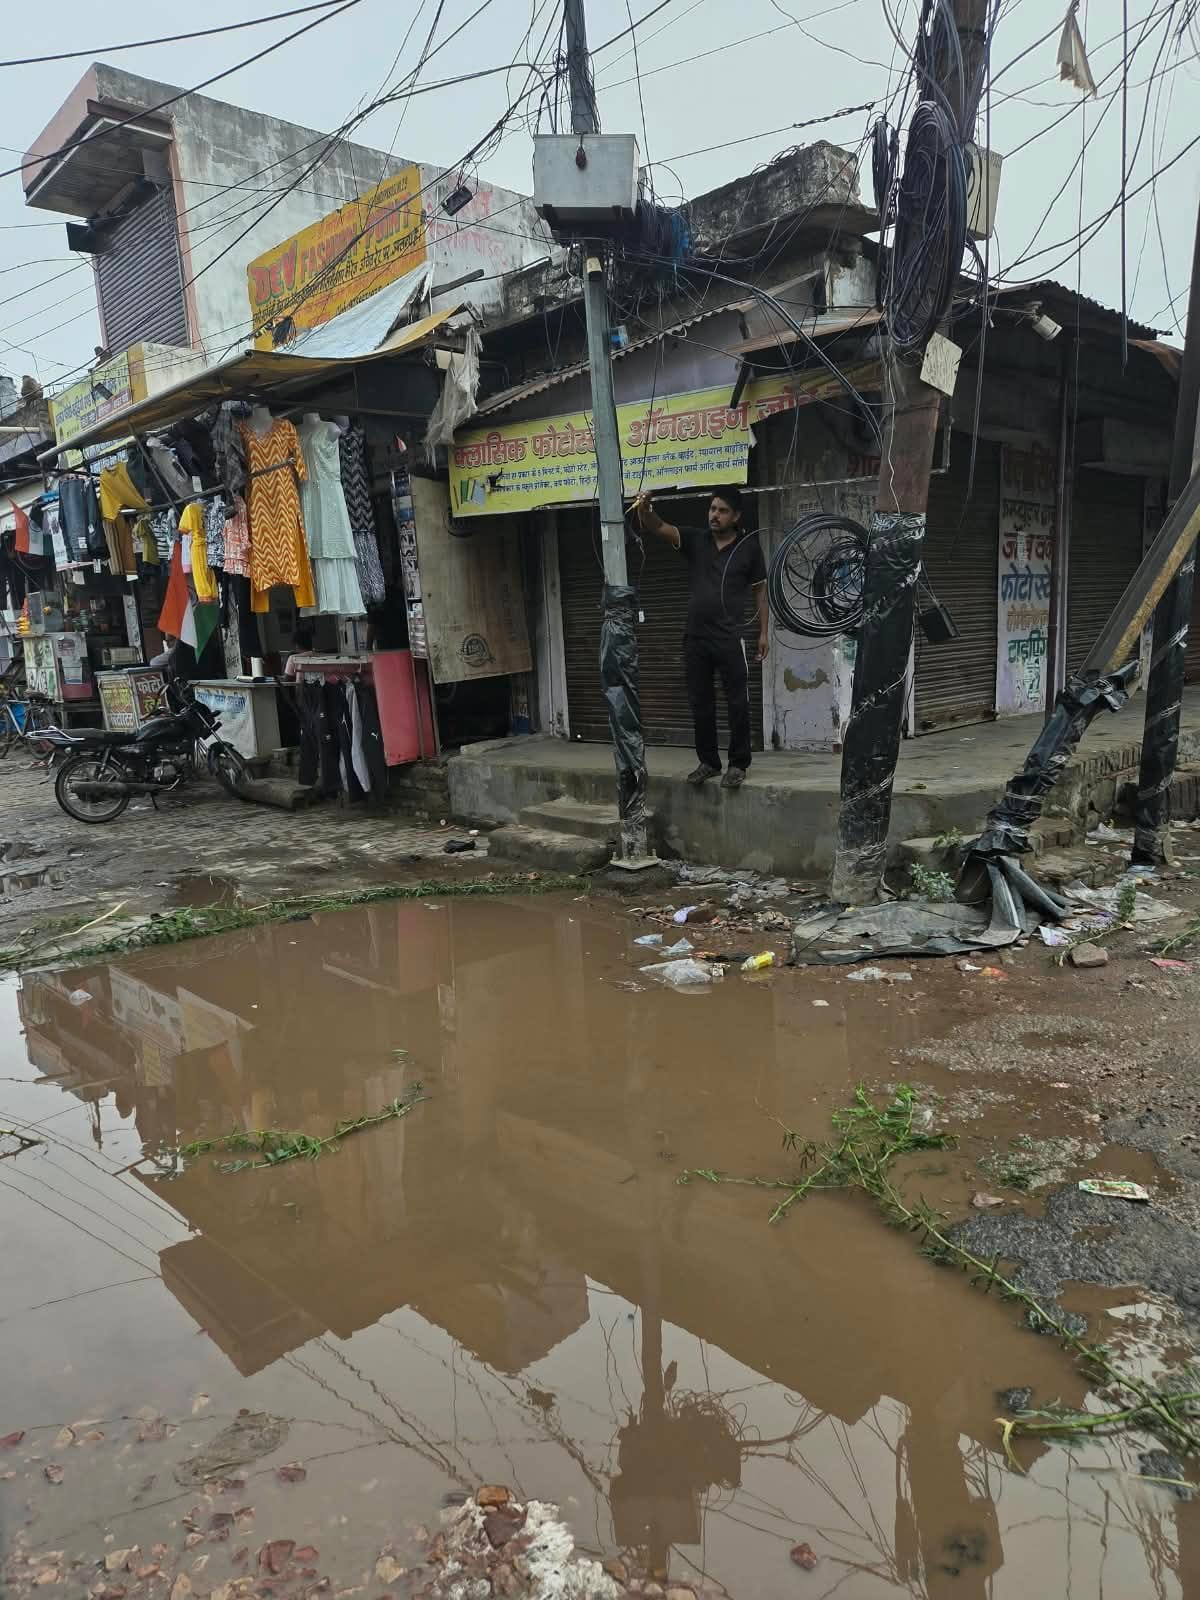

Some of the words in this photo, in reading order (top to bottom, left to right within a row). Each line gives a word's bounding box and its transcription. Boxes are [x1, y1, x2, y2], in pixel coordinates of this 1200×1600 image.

[250, 240, 298, 306] DEV
[301, 222, 359, 285] FASHION
[364, 191, 413, 250] POINT
[1034, 564, 1051, 601] स्टे
